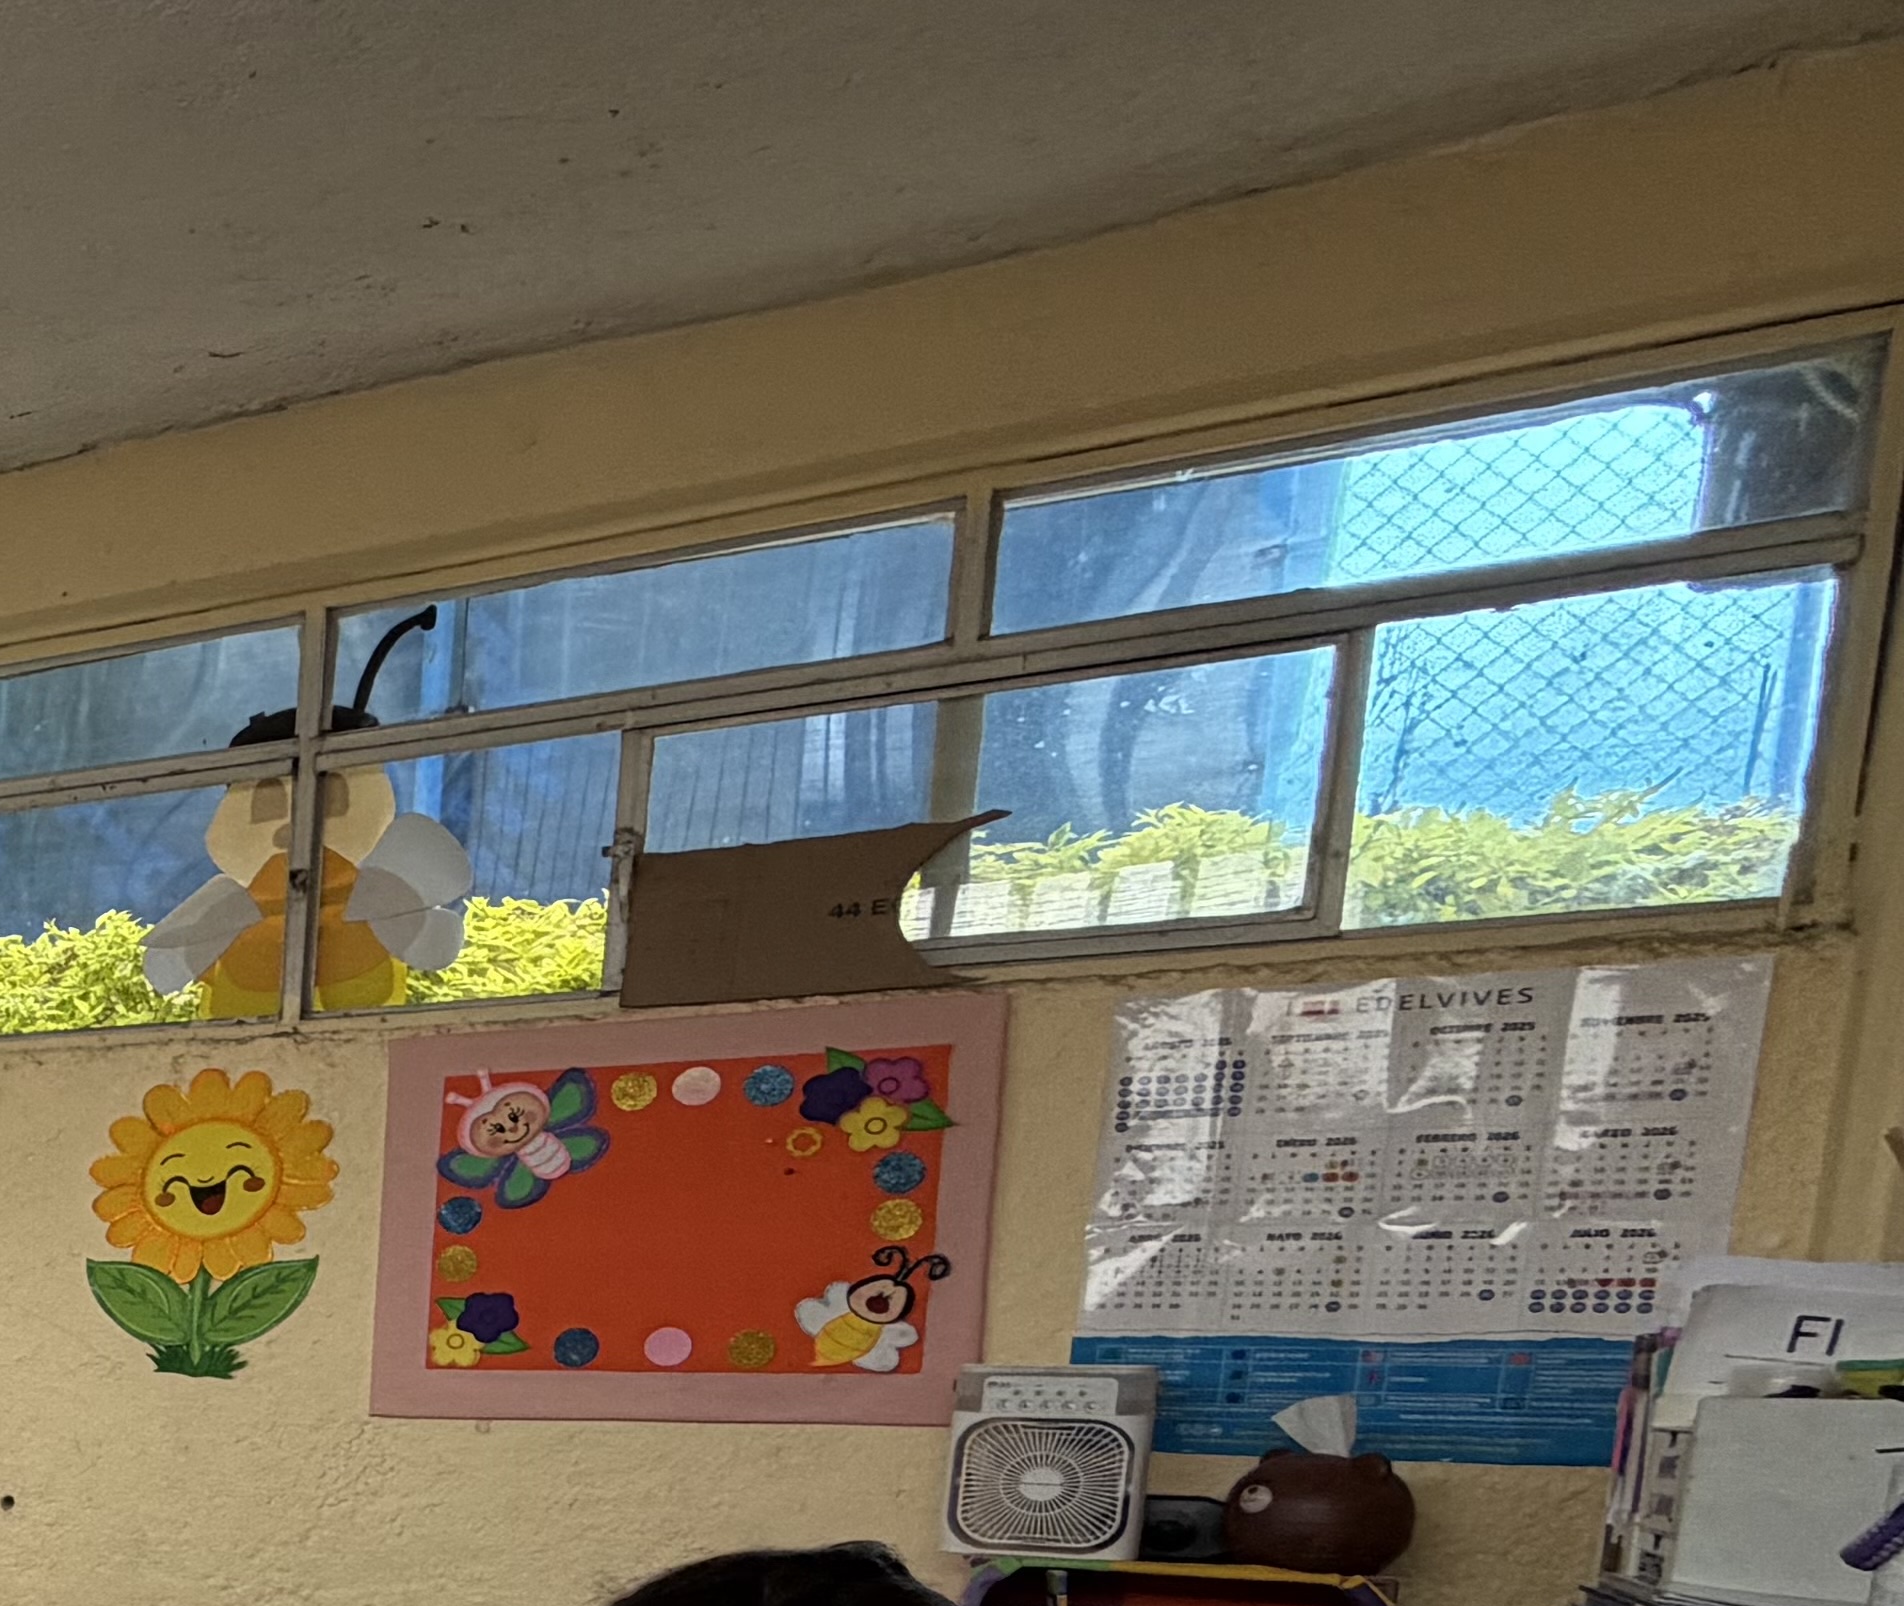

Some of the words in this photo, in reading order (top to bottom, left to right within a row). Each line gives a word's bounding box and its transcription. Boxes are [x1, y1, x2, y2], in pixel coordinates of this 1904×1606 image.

[828, 902, 862, 919] 44
[871, 898, 897, 916] E
[1355, 987, 1535, 1014] EDELVIVES
[1500, 1021, 1536, 1033] 2025
